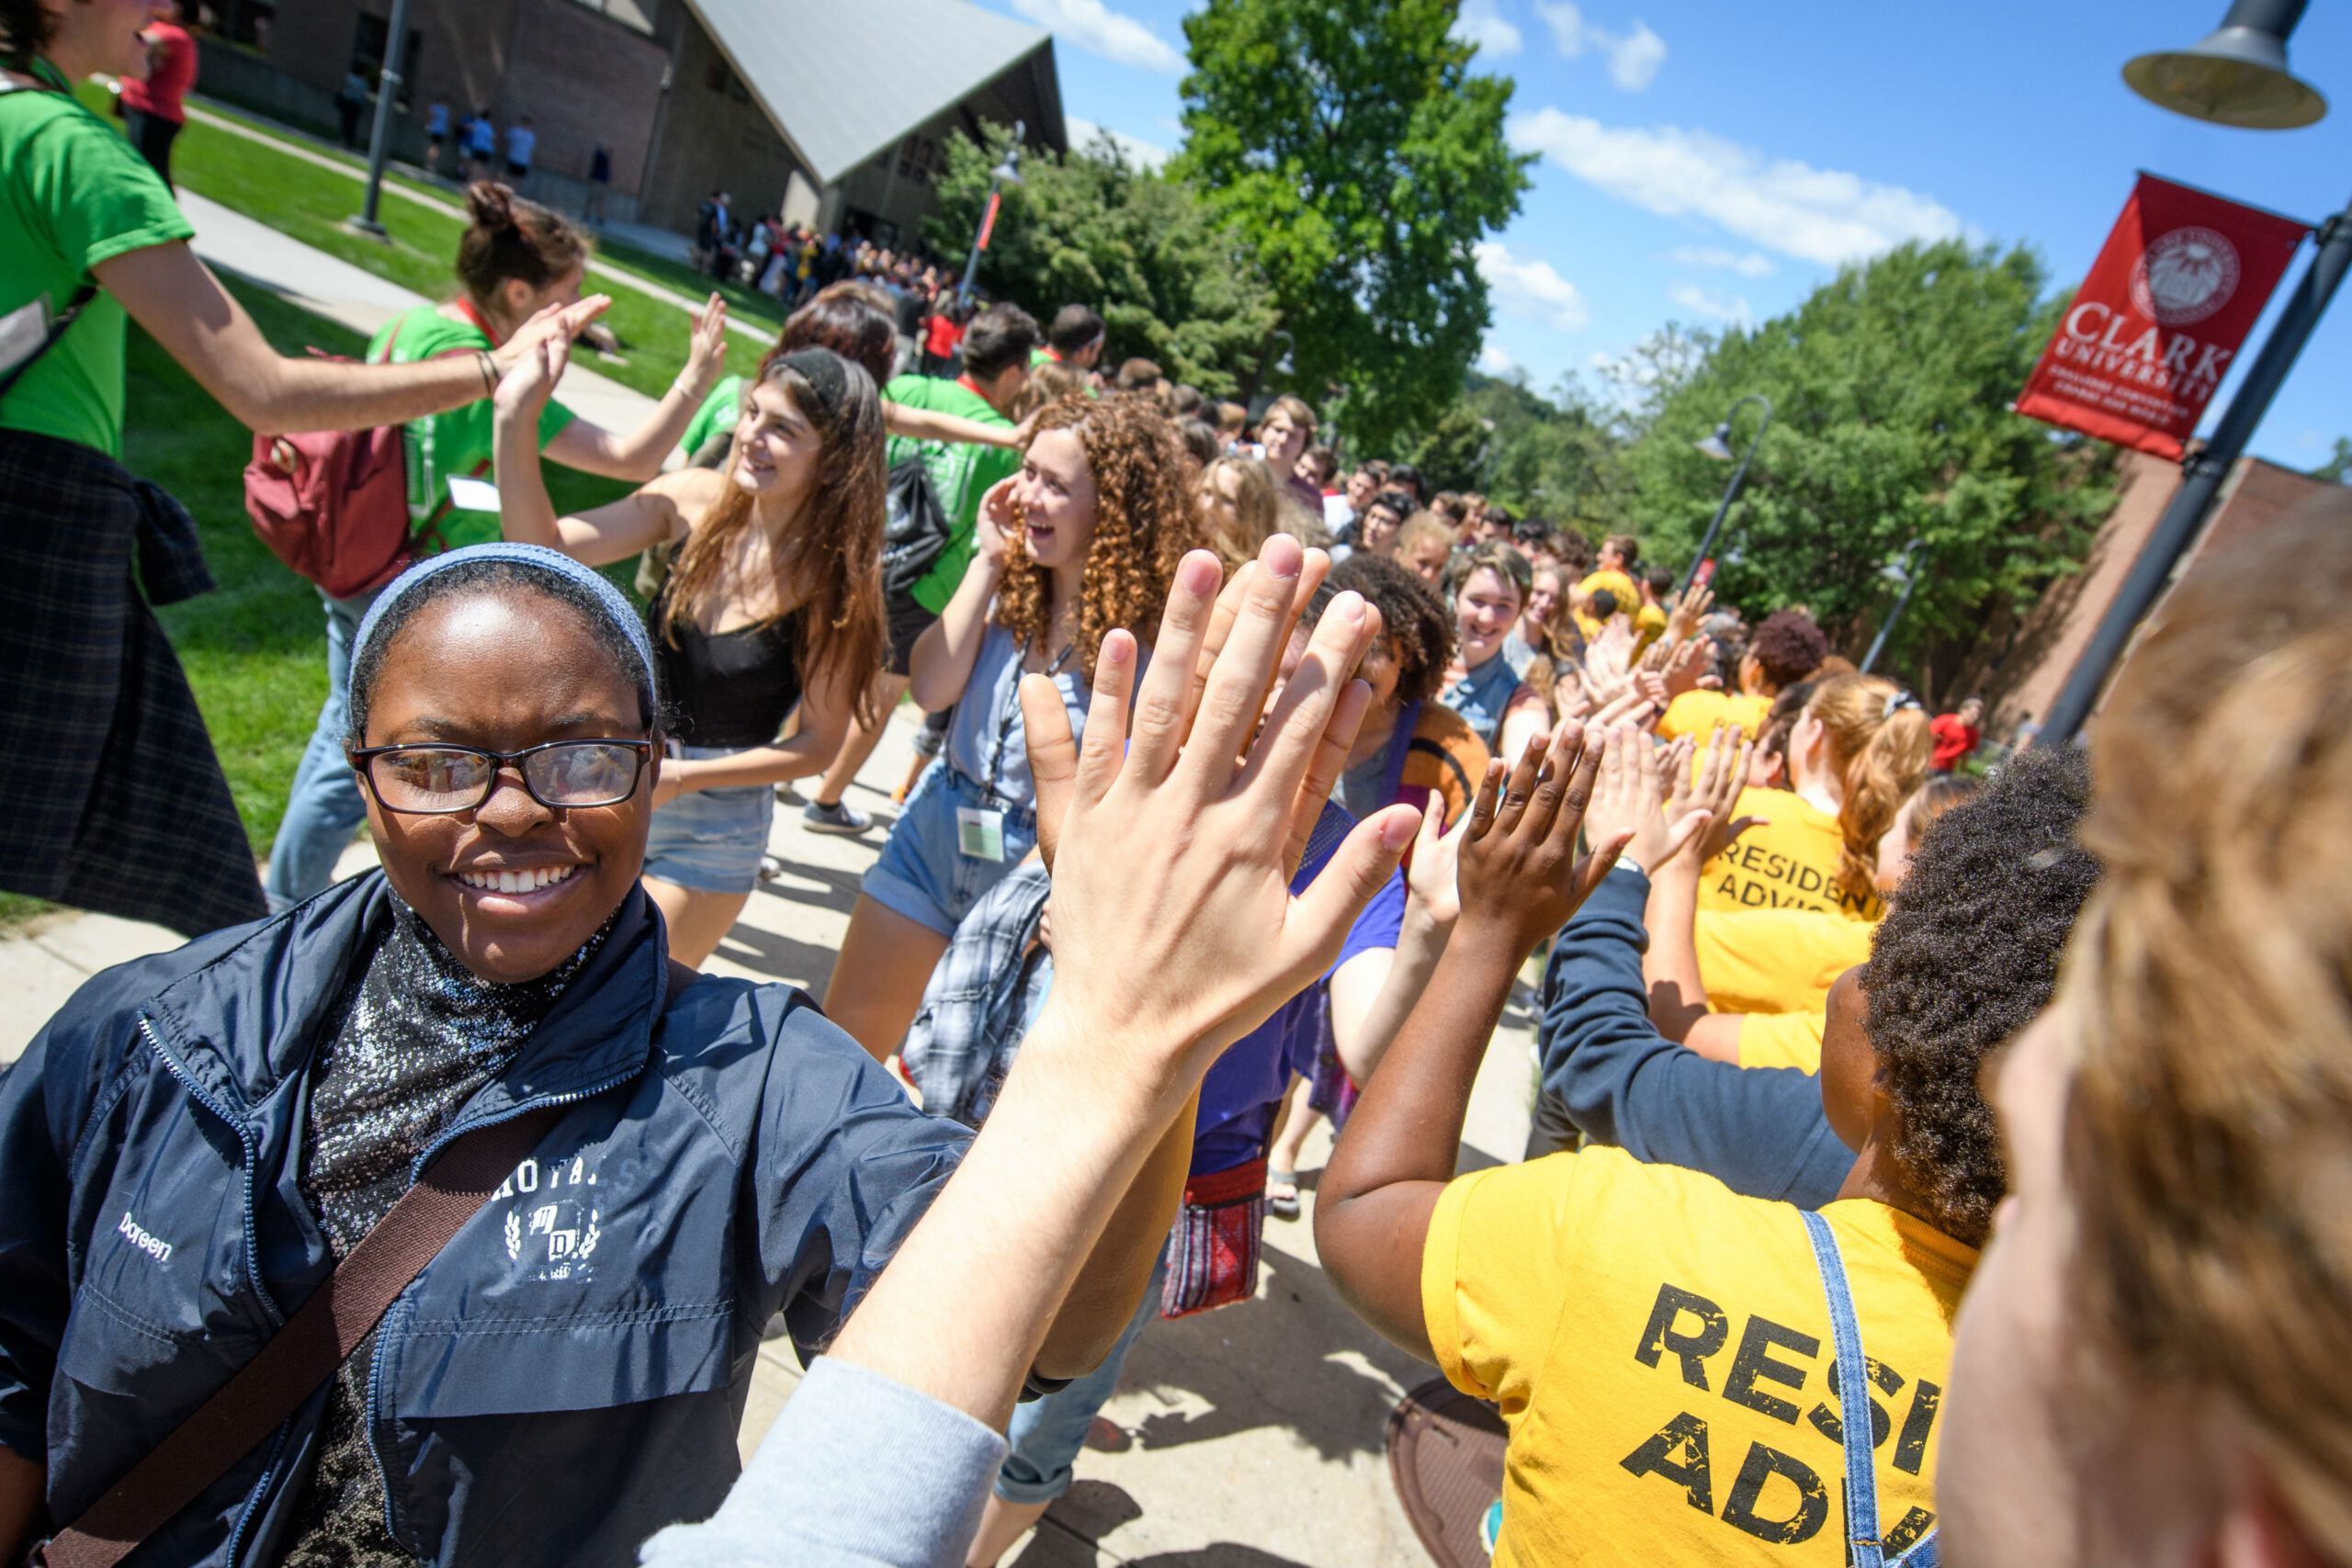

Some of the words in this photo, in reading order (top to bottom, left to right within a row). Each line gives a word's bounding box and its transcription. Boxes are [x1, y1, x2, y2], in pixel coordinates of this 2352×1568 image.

[2055, 337, 2215, 402] UNIVERSITY
[2066, 301, 2233, 383] CLARK
[118, 1211, 173, 1261] Doreen
